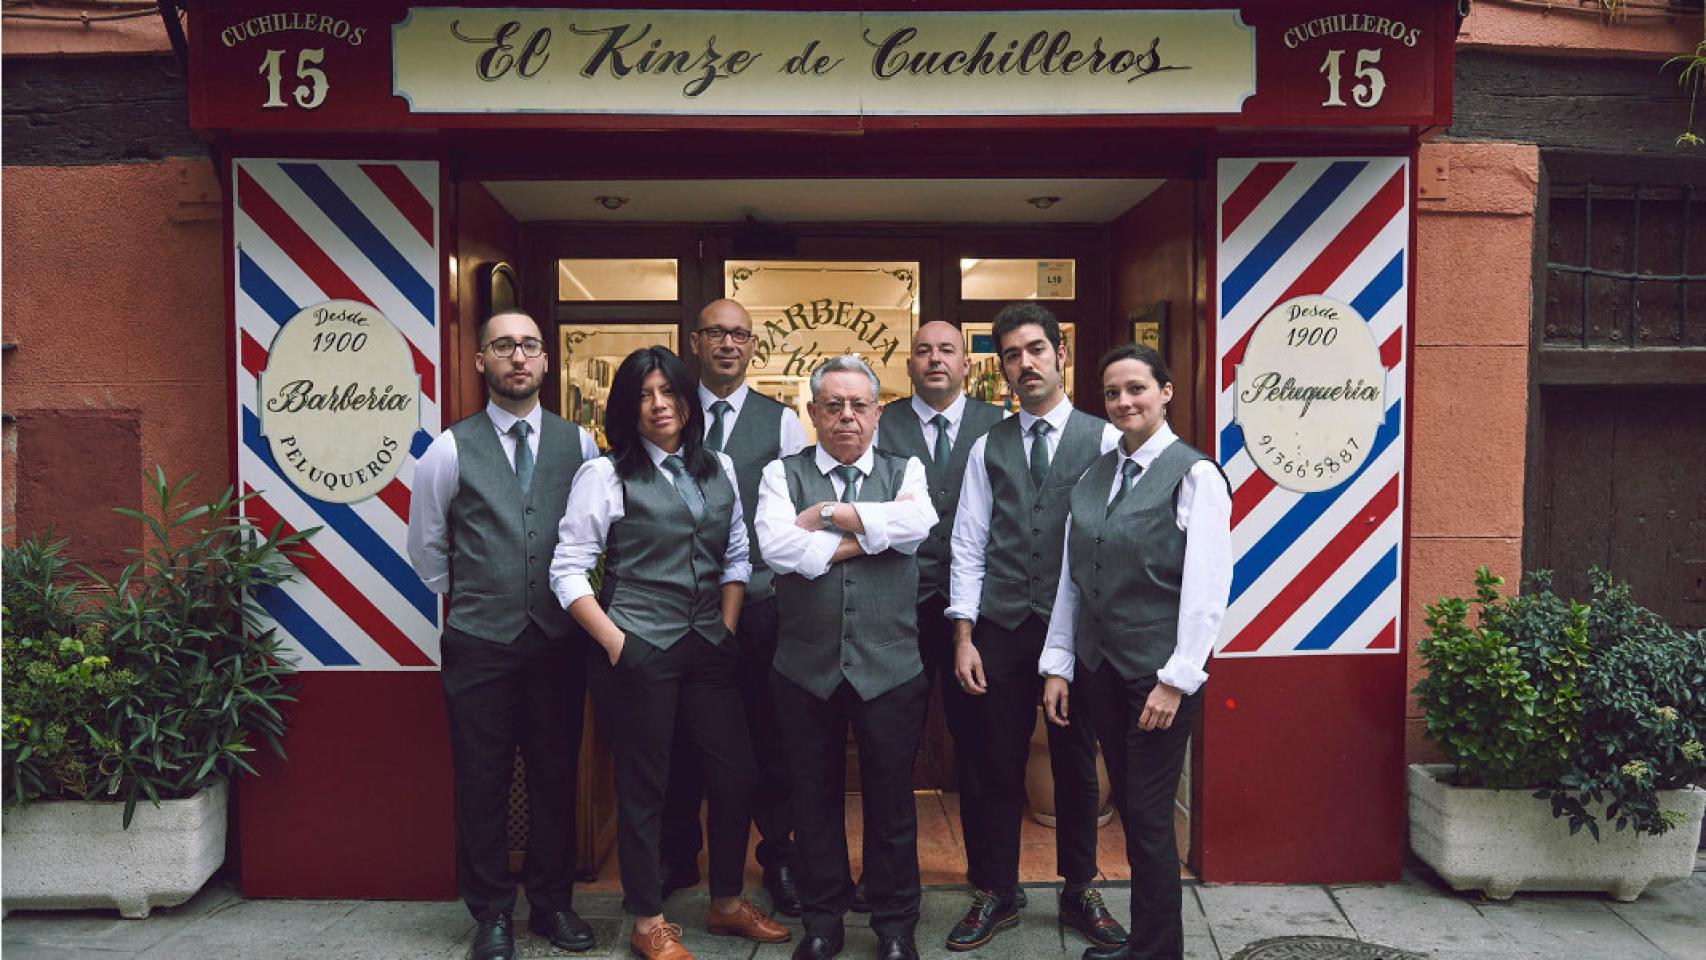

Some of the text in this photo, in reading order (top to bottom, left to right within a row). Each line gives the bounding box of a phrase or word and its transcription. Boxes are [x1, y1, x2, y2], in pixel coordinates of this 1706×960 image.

[220, 12, 368, 47] CUCHILLEROS
[1283, 13, 1422, 49] CUCHILLEROS
[450, 20, 1193, 99] El Kinze de Cuchilleros
[258, 47, 330, 109] 15
[1319, 47, 1386, 108] 15
[313, 307, 370, 327] Desde
[1287, 304, 1340, 322] Desde
[312, 331, 369, 352] 1900
[1287, 326, 1339, 348] 1900
[280, 435, 399, 491] PELUQUEROS
